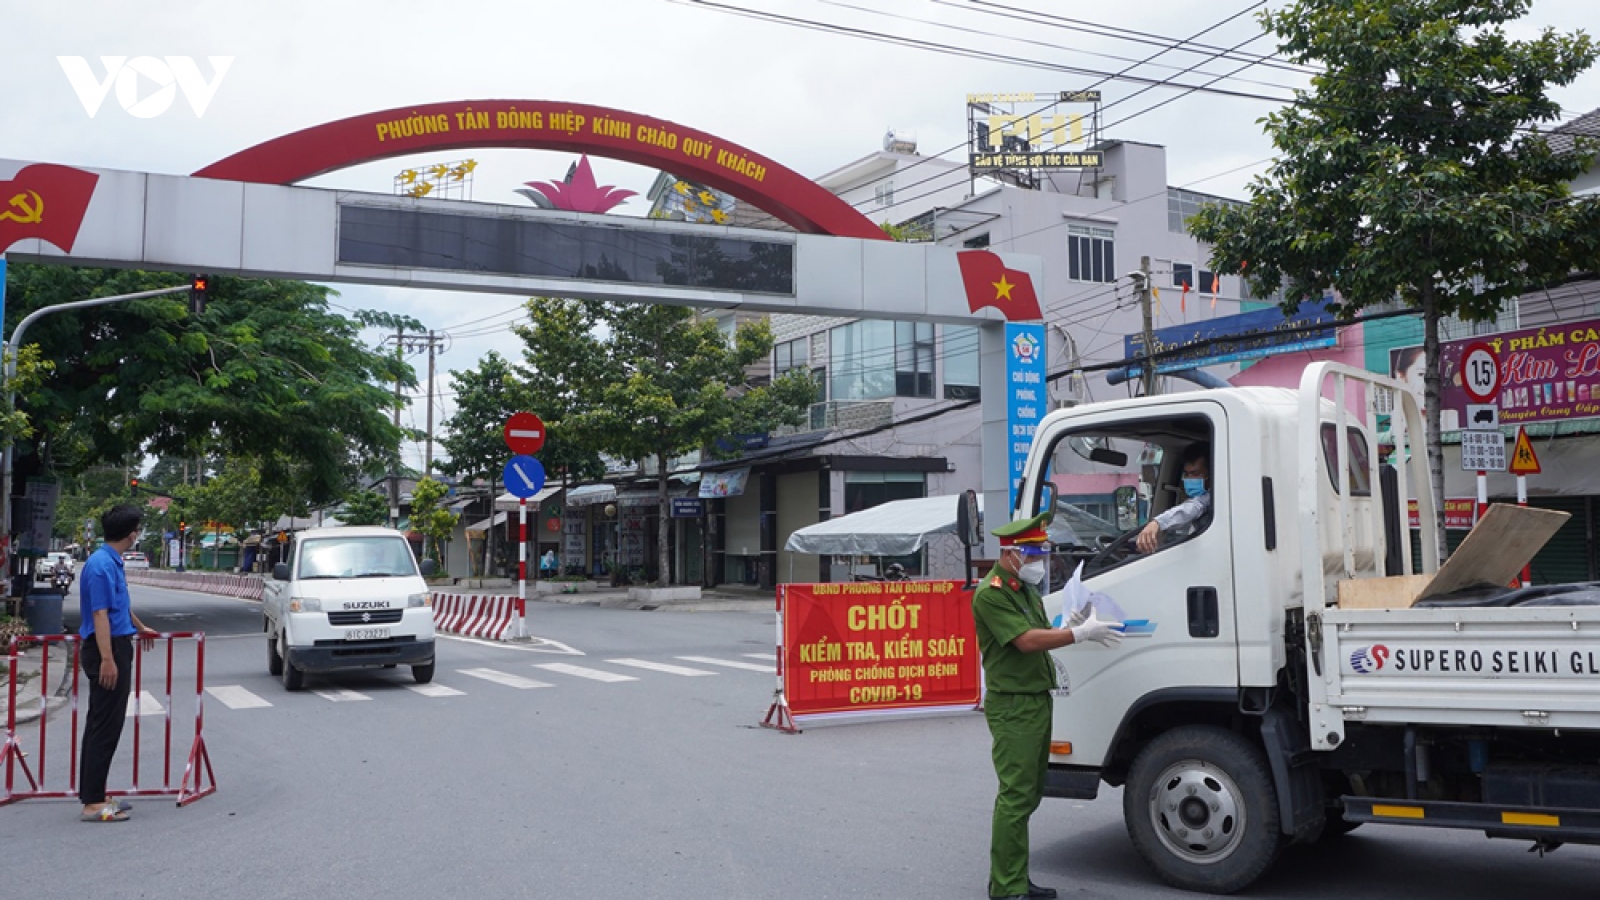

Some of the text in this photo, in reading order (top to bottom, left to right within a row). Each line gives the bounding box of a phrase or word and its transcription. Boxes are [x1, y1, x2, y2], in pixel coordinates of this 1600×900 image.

[989, 114, 1083, 146] PHI
[376, 106, 767, 182] PHƯỜNG TÂN ĐÔNG HIỆP KÍNH CHÀO QUÝ KHÁCH
[1487, 328, 1600, 353] Ỹ PHẨM CA
[1501, 352, 1559, 386] Kim
[813, 583, 840, 595] UBND
[843, 582, 882, 594] PHƯỜNG
[932, 580, 954, 594] HIỆP
[343, 601, 390, 610] SUZUKI
[847, 596, 922, 631] CHỐT
[800, 633, 966, 663] KIỂM TRA, KIỂM SOÁT
[810, 663, 958, 683] PHÒNG CHỐNG DỊCH BỆNH
[1395, 649, 1600, 675] SUPERO SEIKI GL
[850, 684, 922, 704] COVID-19
